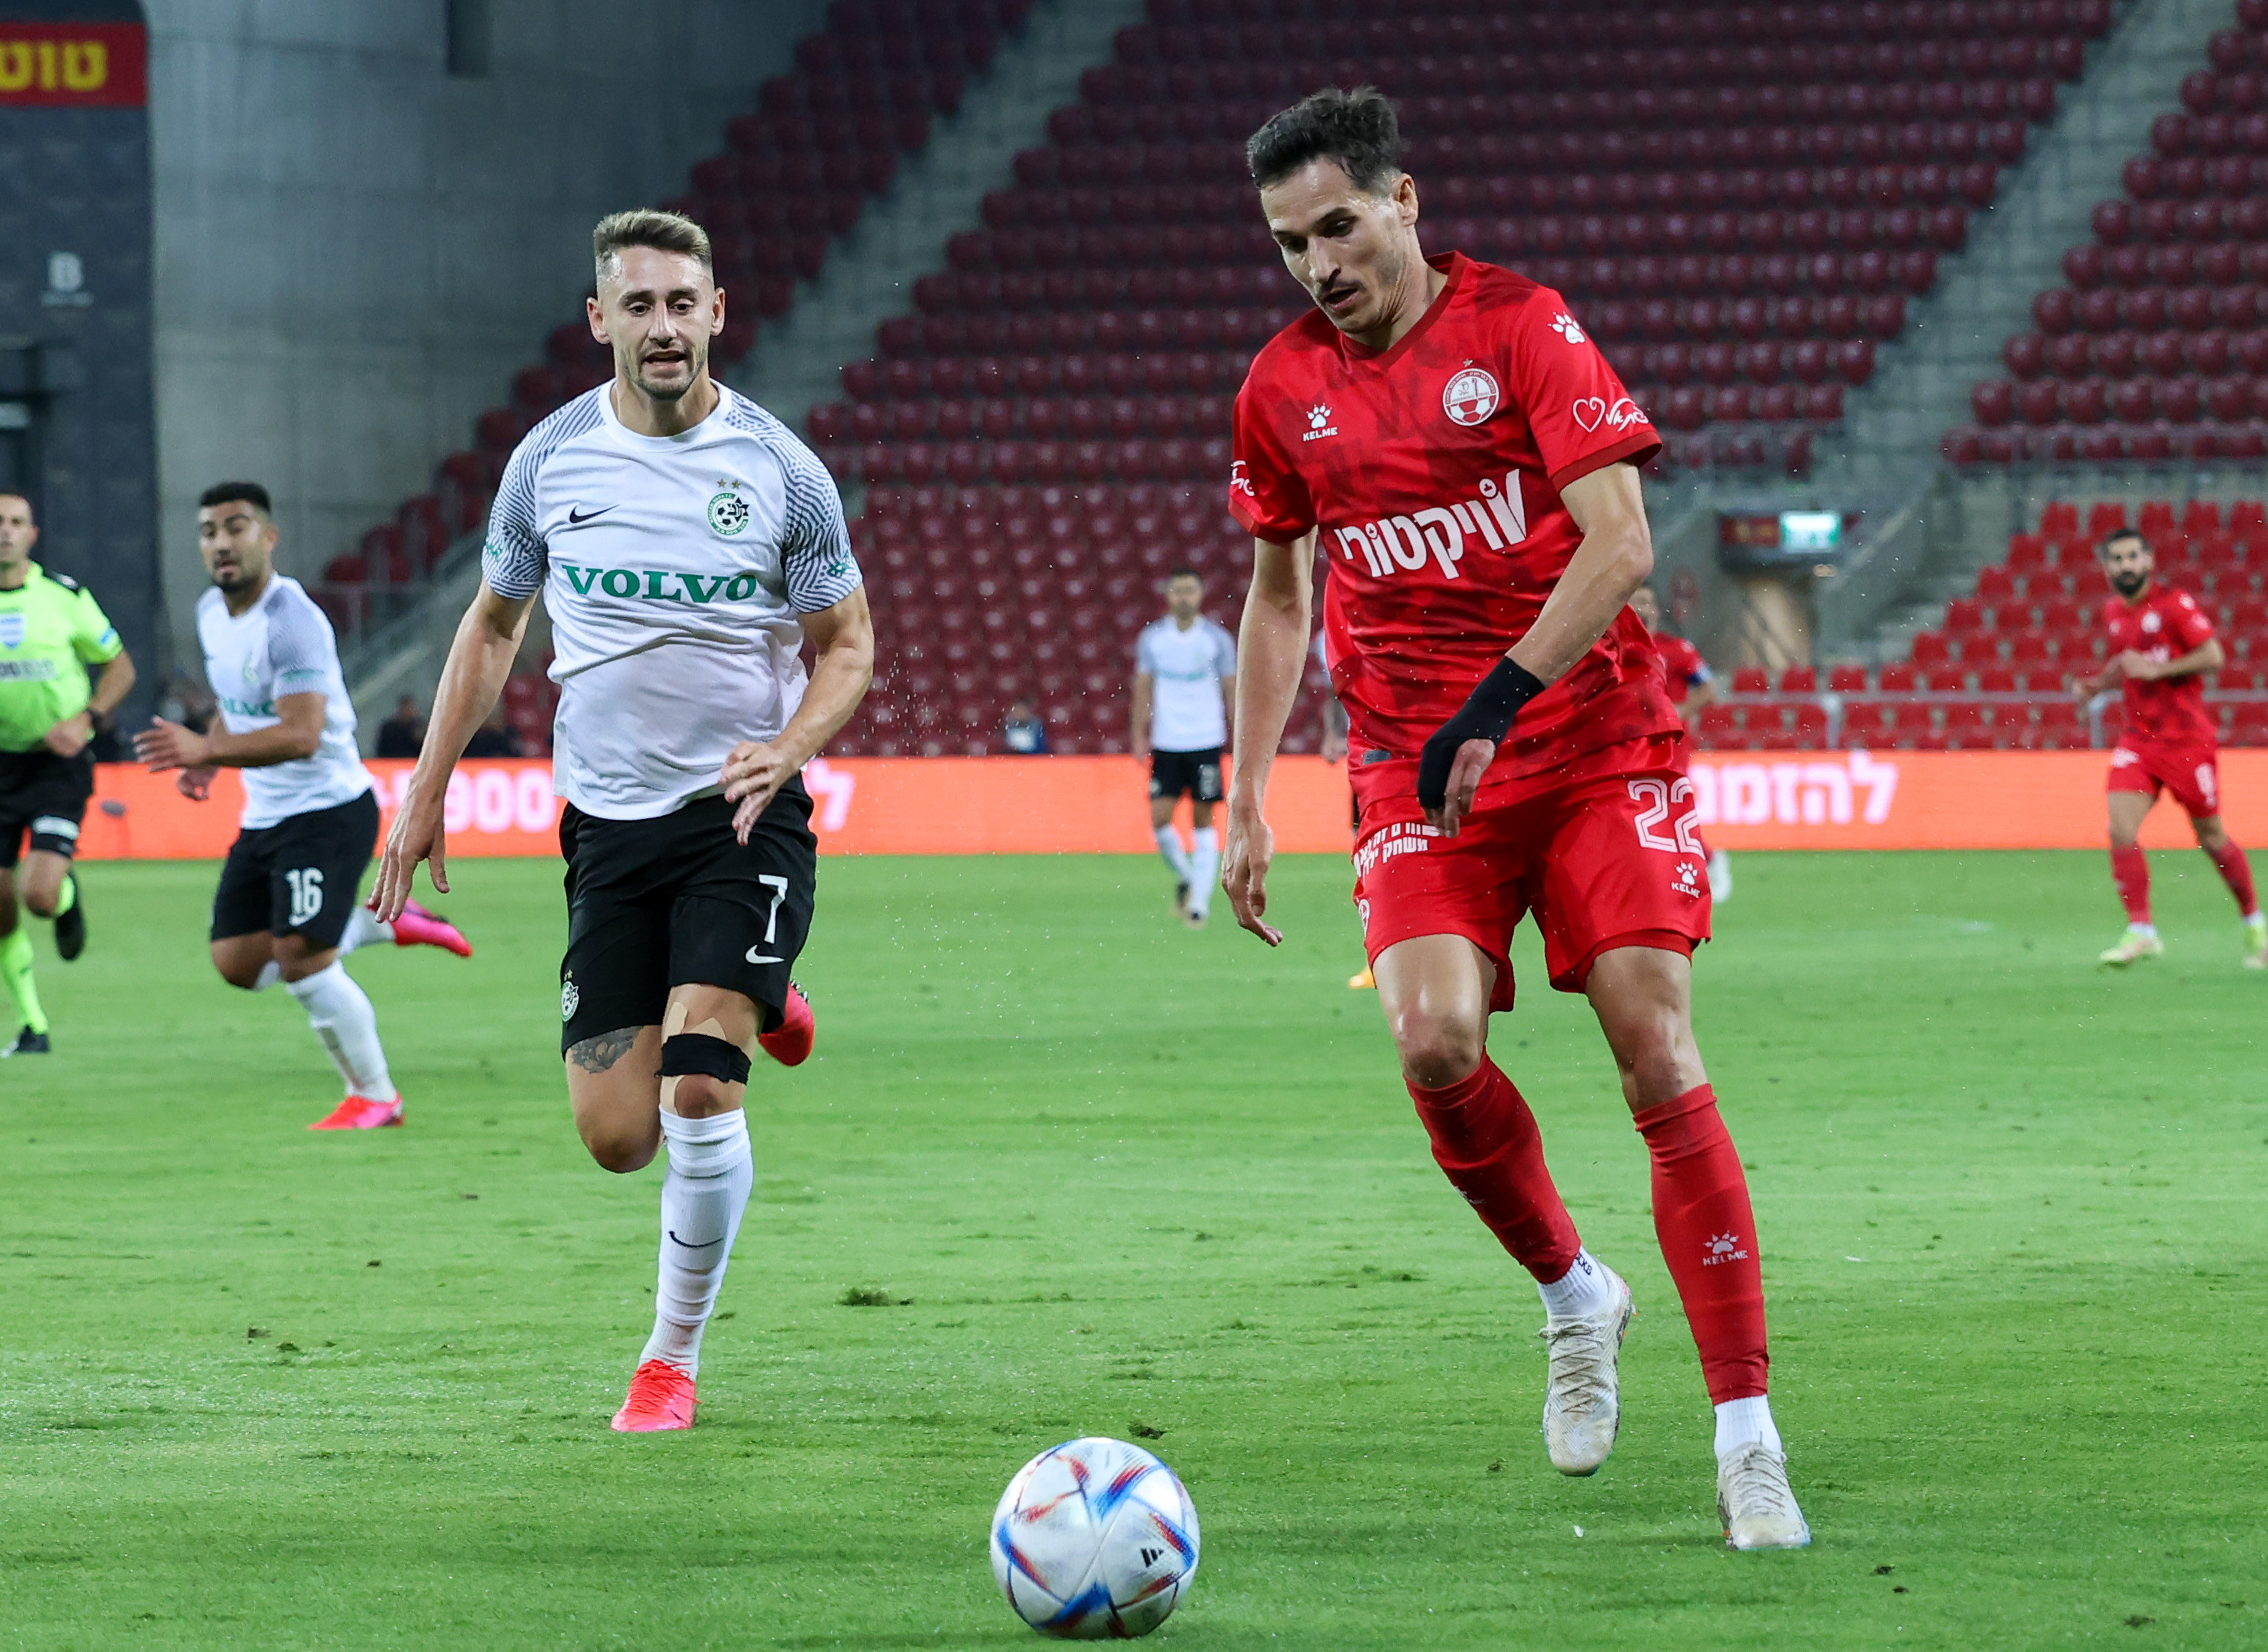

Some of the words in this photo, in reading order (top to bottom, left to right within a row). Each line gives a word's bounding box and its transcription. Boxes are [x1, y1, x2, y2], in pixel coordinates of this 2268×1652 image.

[1302, 426, 1339, 442] KELME
[561, 564, 756, 603] VOLVO
[1628, 776, 1706, 860] 22
[1382, 836, 1429, 864] משחק
[284, 866, 324, 914] 16
[1670, 881, 1701, 899] KELME
[758, 874, 789, 944] 7
[1703, 1249, 1750, 1266] KELME
